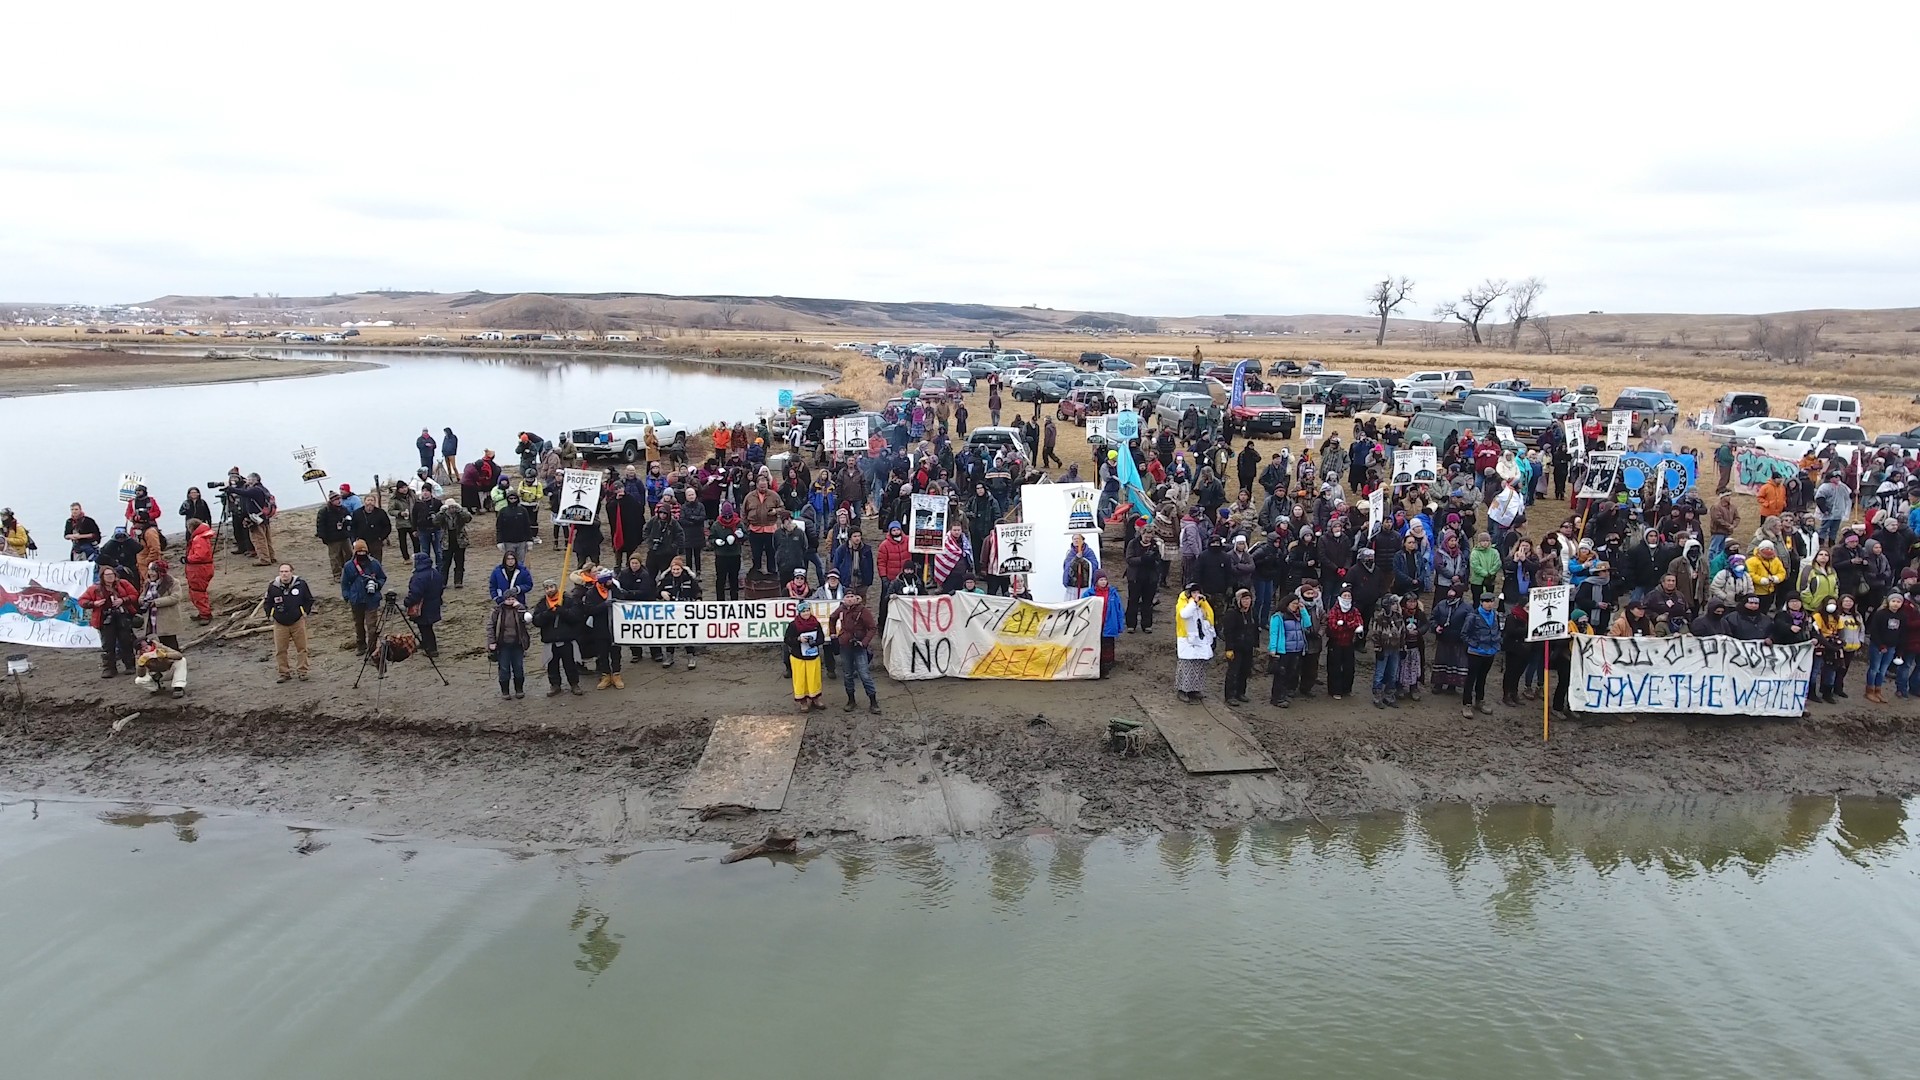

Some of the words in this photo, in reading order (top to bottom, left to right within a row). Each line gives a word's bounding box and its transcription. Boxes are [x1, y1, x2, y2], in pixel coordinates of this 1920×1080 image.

[293, 451, 316, 460] PROTECT
[1590, 463, 1615, 471] WATER
[566, 476, 598, 486] PROTECT
[1071, 490, 1094, 501] WATER
[1001, 530, 1032, 539] PROTECT
[1003, 559, 1030, 567] WATER
[1533, 591, 1566, 601] PROTECT
[621, 604, 676, 620] WATER
[684, 603, 767, 619] SUSTAINS
[775, 602, 797, 619] US
[911, 596, 954, 634] NO
[621, 623, 699, 639] PROTECT
[707, 622, 740, 639] OUR
[747, 622, 791, 638] EART
[1537, 622, 1564, 634] WATER
[911, 637, 951, 674] NO
[1584, 673, 1664, 708] SAVE
[1668, 673, 1726, 708] THE
[1731, 676, 1808, 711] WATER
